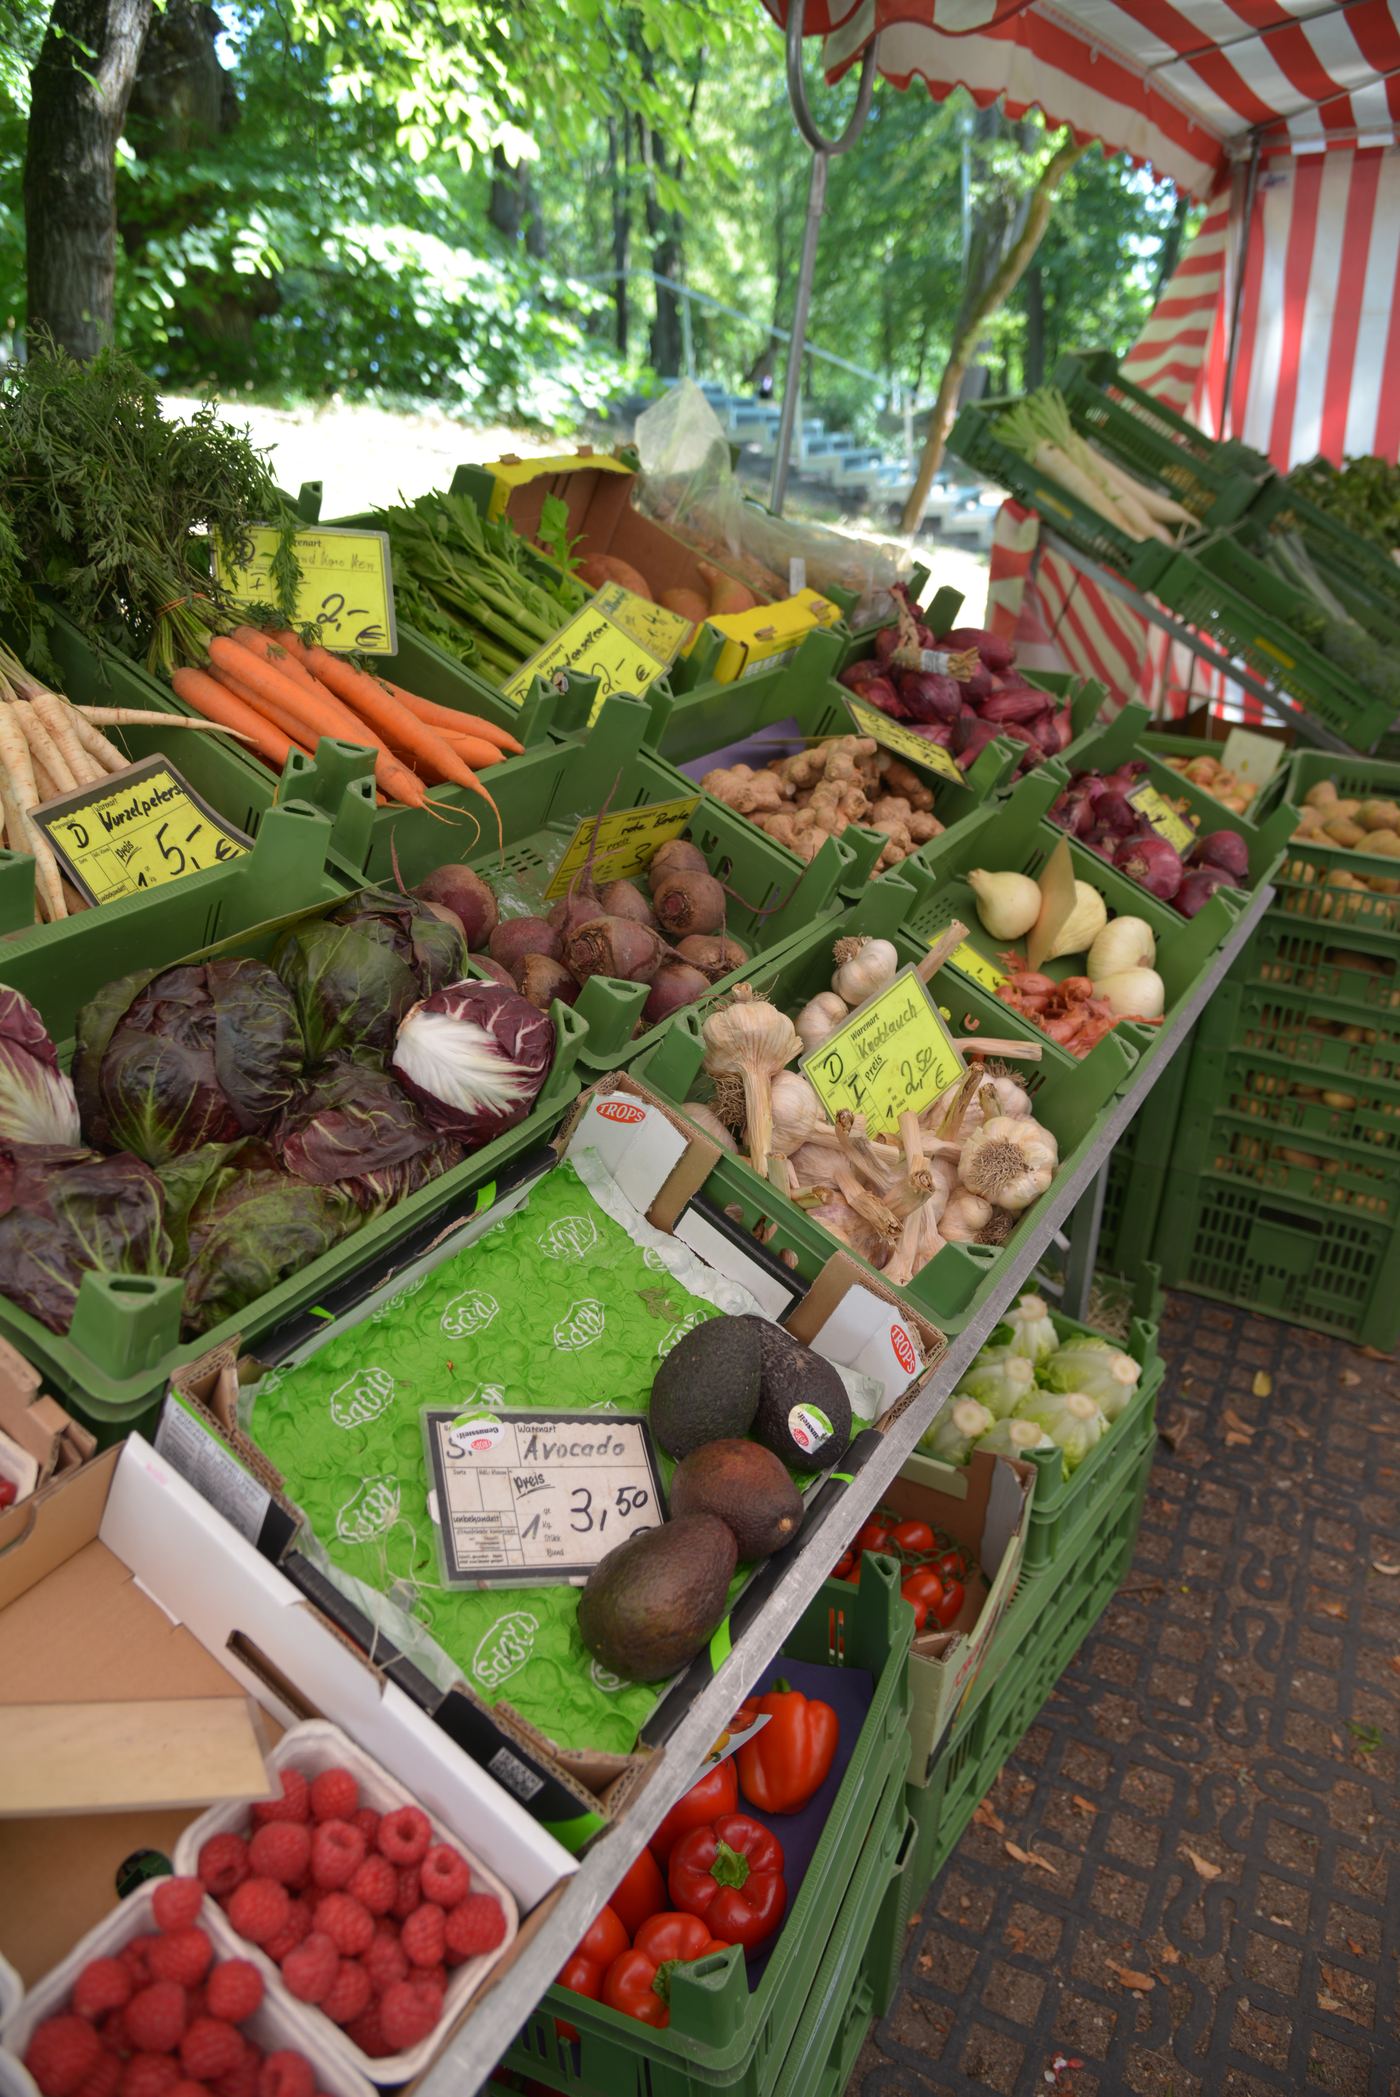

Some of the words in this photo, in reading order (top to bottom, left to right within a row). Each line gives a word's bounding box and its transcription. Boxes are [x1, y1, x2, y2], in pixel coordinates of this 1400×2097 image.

[355, 625, 386, 646] €
[67, 823, 90, 849] D
[215, 838, 240, 862] €
[138, 872, 148, 888] 1
[850, 1013, 880, 1041] Warenart
[858, 998, 919, 1060] Knoblauch
[823, 1052, 844, 1085] D
[935, 1063, 948, 1090] €
[599, 1103, 644, 1122] TROPS
[886, 1104, 894, 1119] 1
[891, 1326, 916, 1374] TROPS
[517, 1425, 556, 1433] Warenart
[524, 1435, 625, 1461] Avocado
[571, 1486, 648, 1532] 3,50
[521, 1514, 541, 1540] 1
